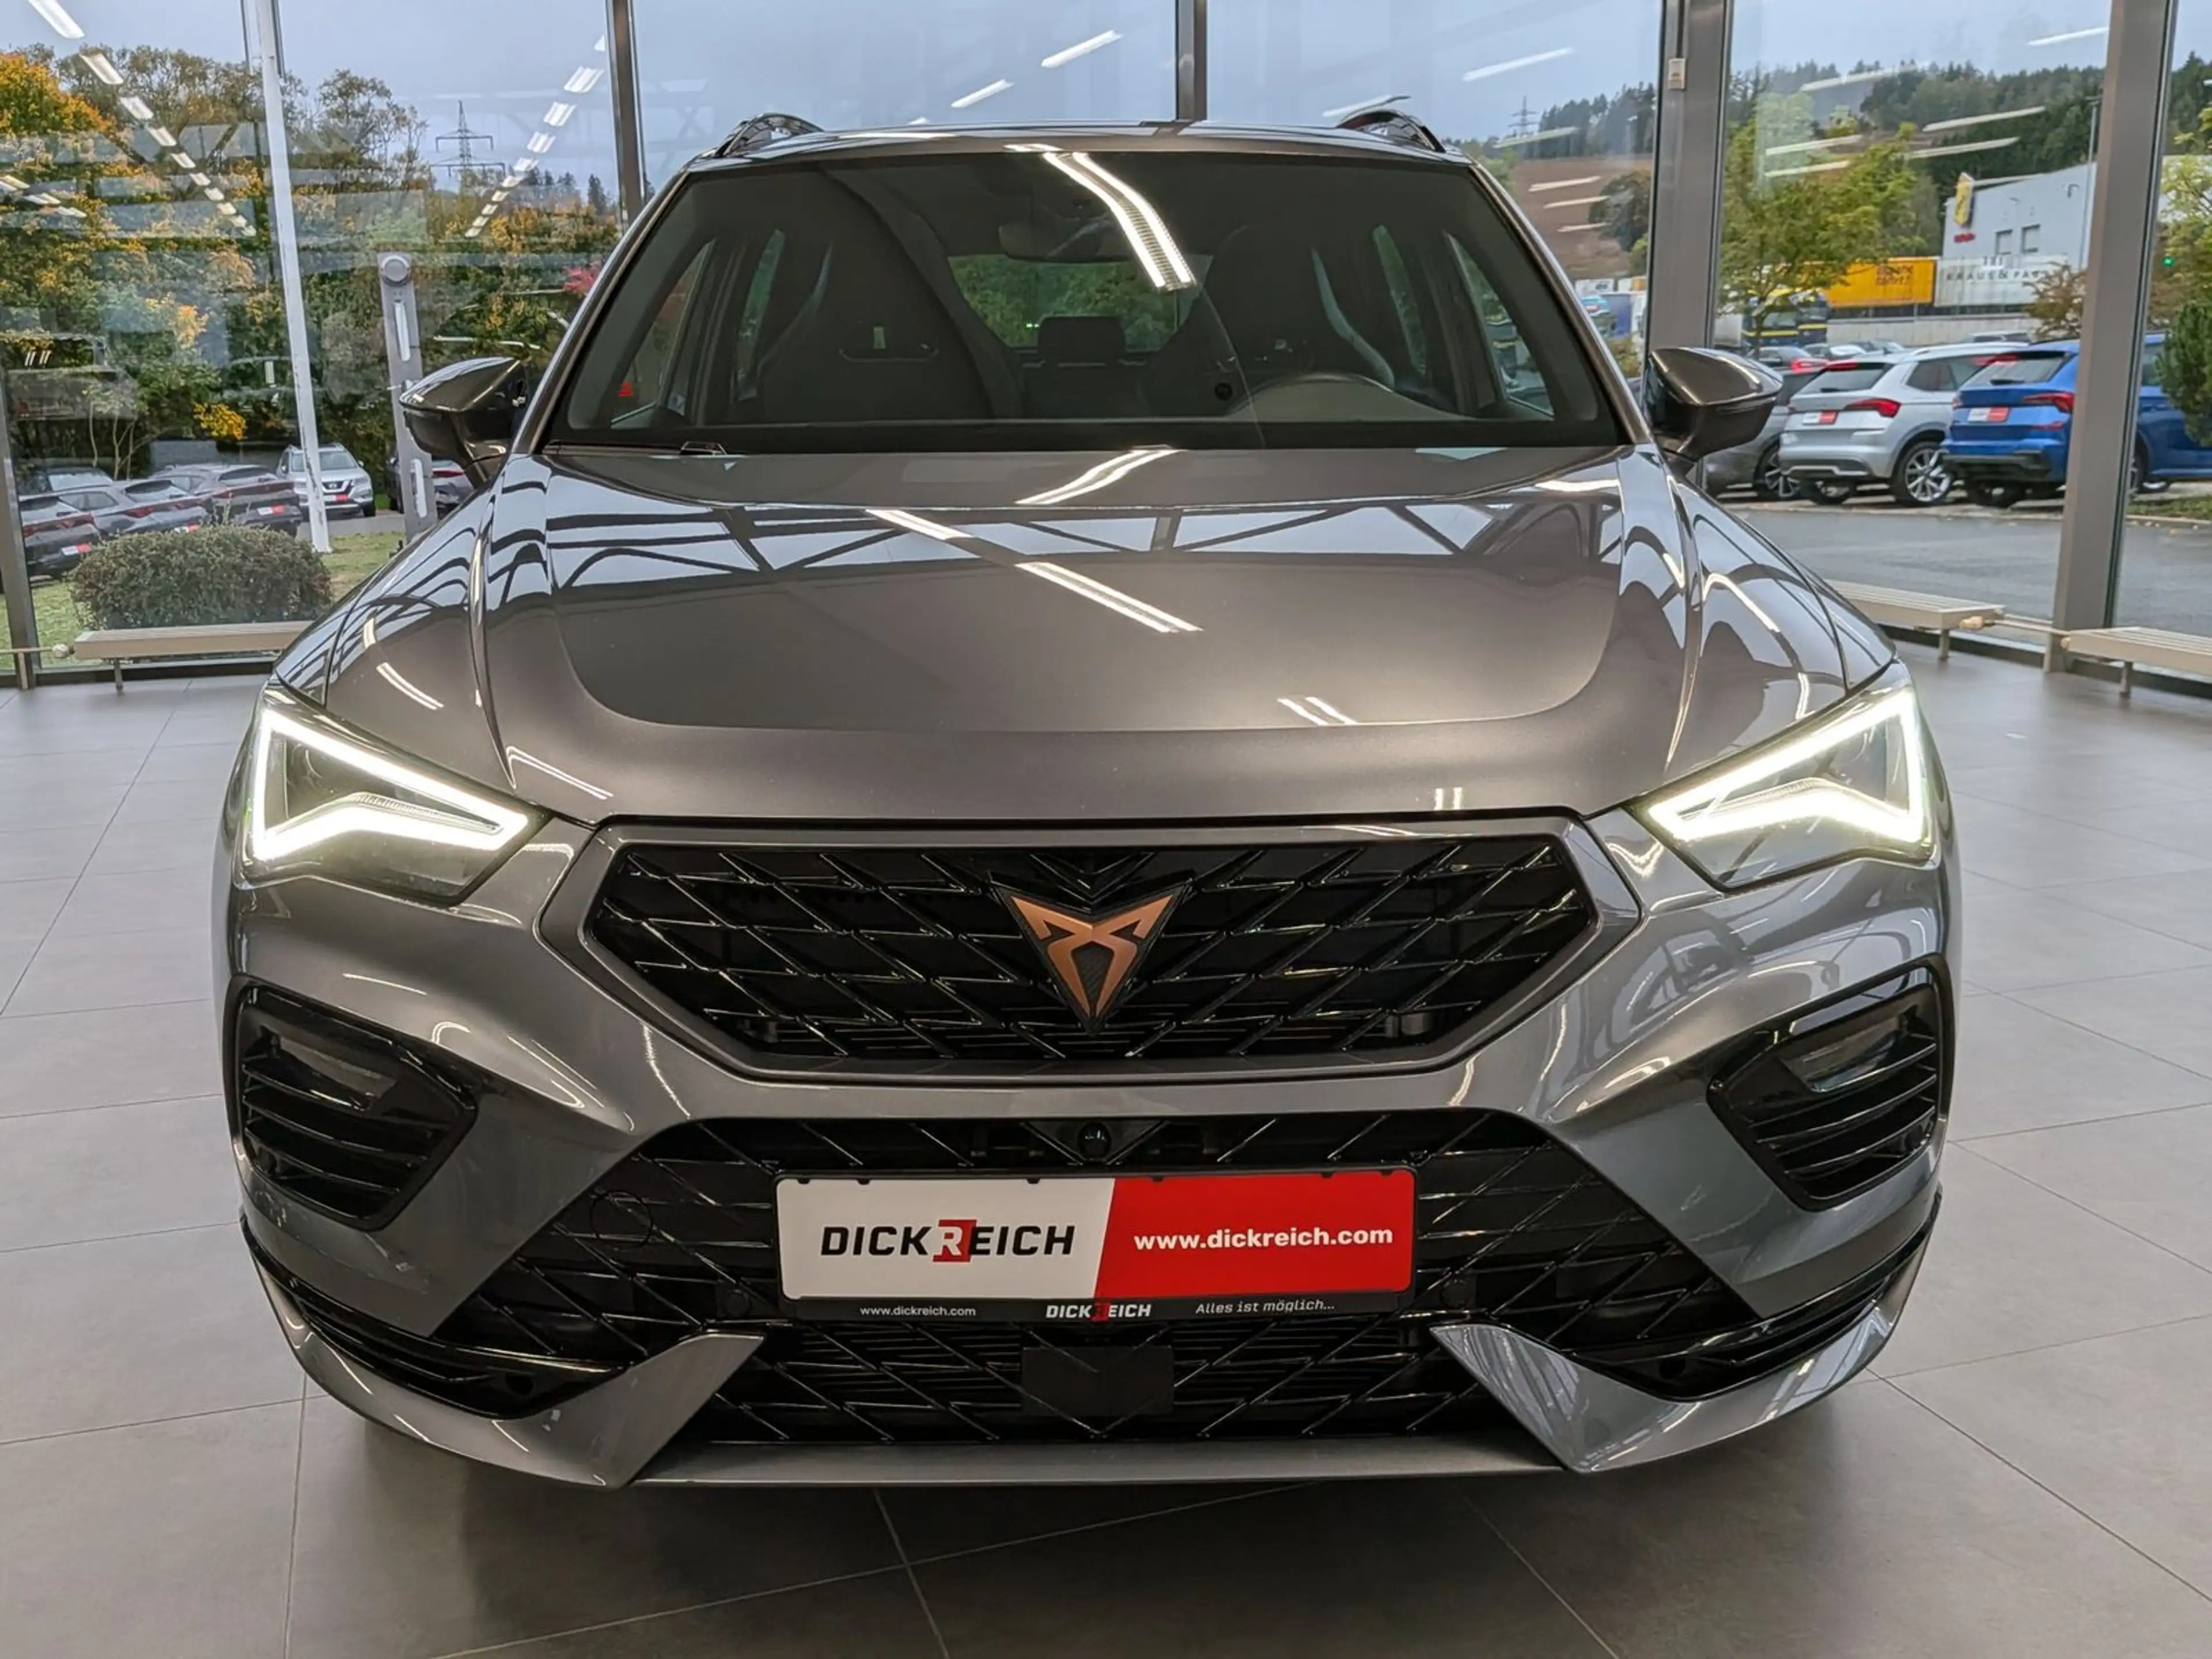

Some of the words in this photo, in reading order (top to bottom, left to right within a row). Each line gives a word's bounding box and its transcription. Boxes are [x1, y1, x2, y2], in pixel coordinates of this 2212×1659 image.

[820, 1224, 1075, 1258] DICKREICH
[1133, 1227, 1393, 1251] www.dickreich.com
[859, 1305, 976, 1317] www.dickreich.com
[1195, 1302, 1233, 1315] Alles
[1237, 1300, 1260, 1313] ist
[1263, 1298, 1335, 1313] möglich...
